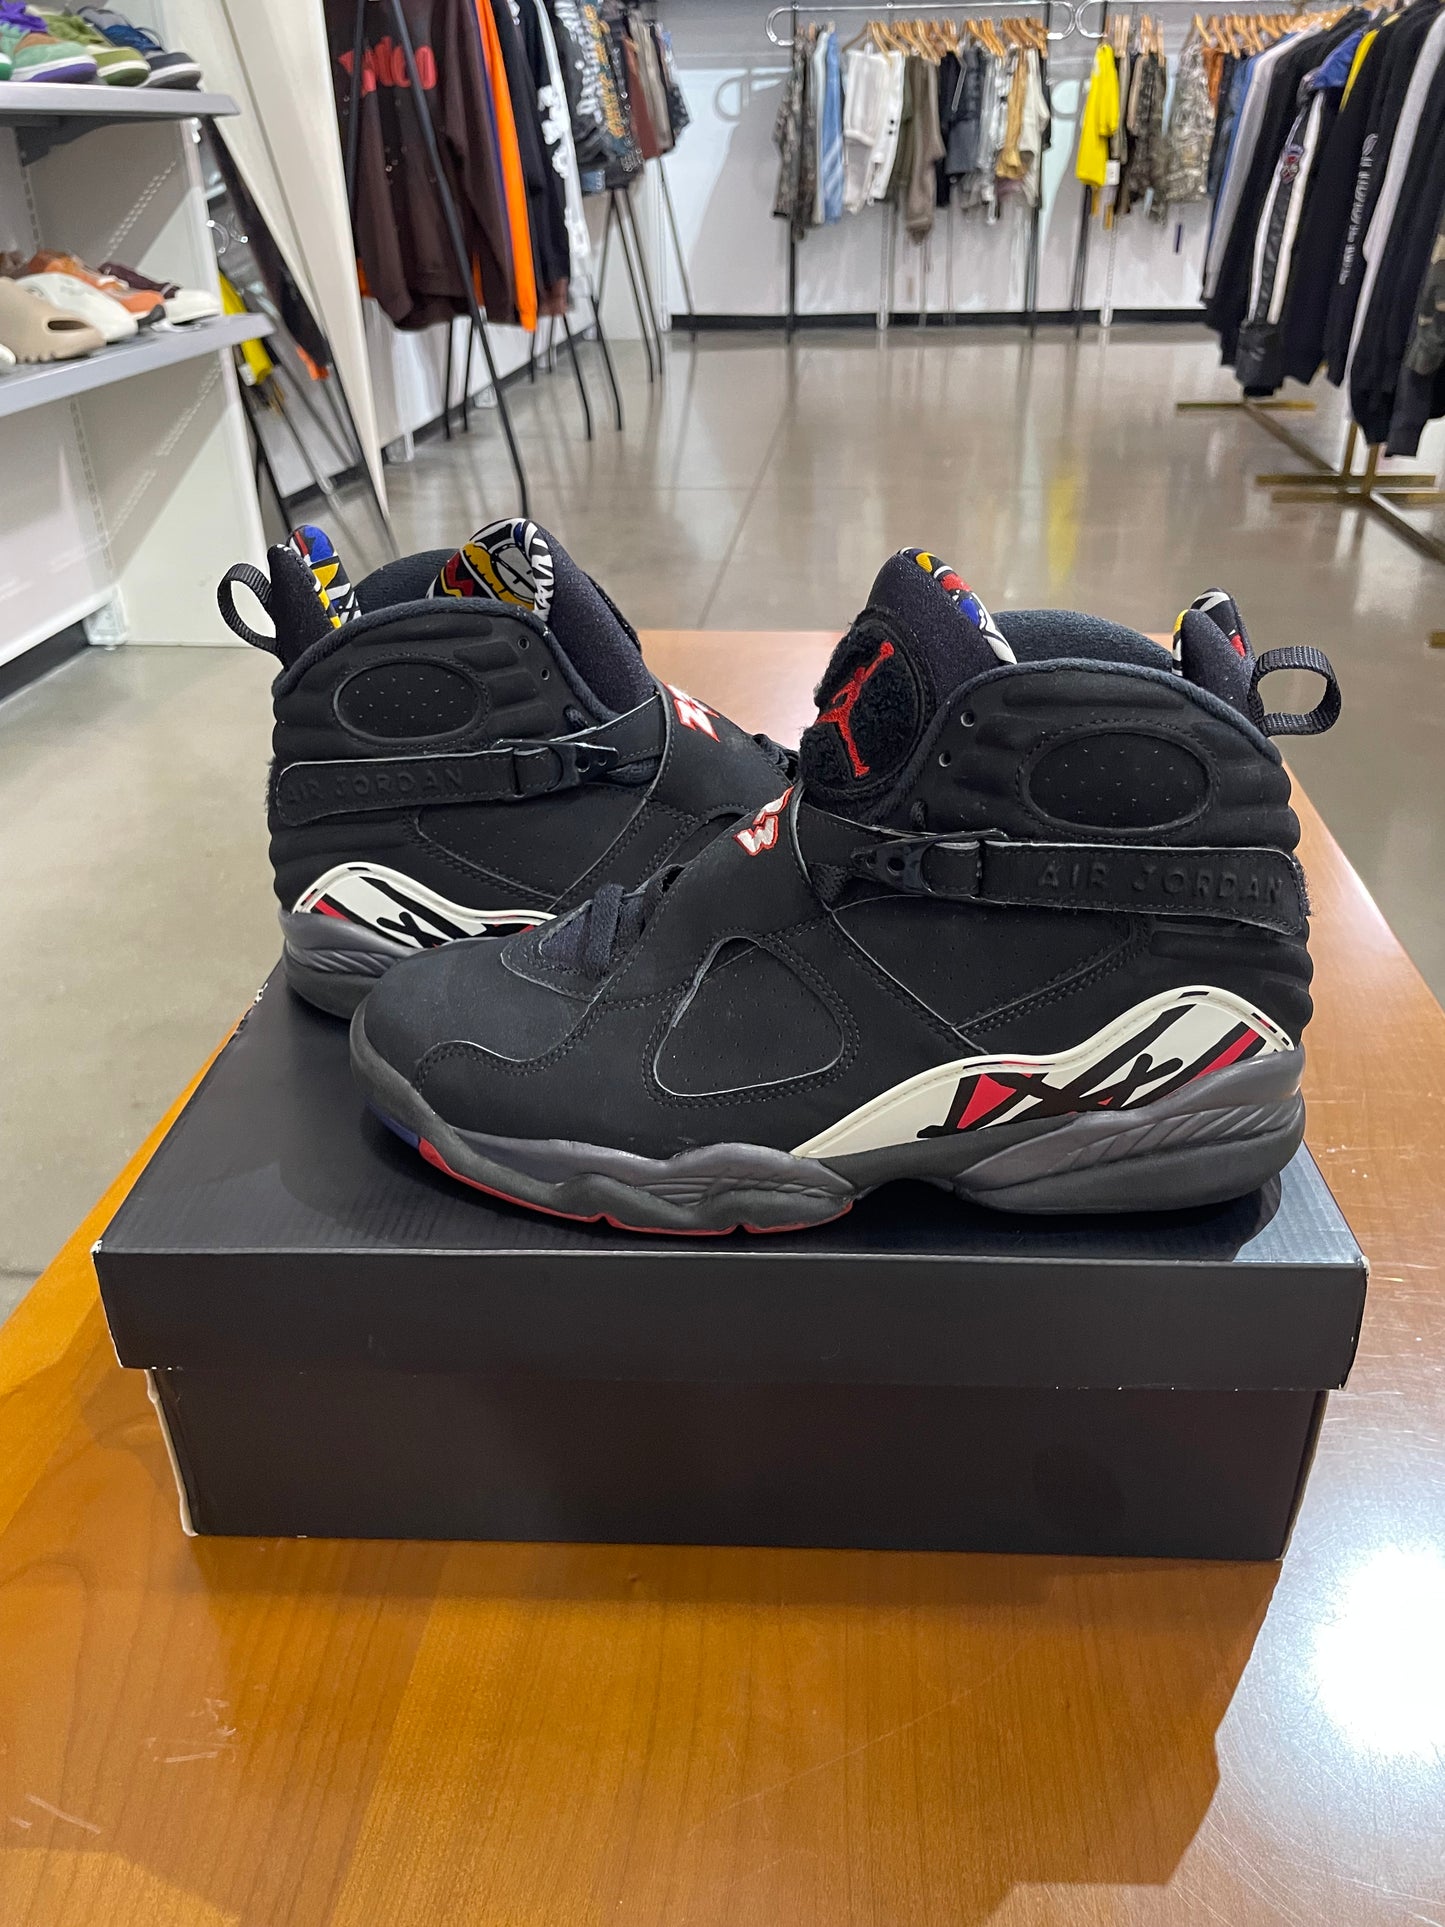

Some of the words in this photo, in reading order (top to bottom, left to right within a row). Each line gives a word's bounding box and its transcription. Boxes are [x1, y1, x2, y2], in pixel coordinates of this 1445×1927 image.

[335, 767, 463, 797] JORDAN
[1037, 861, 1109, 889] AIR
[1132, 864, 1282, 902] JORDAN
